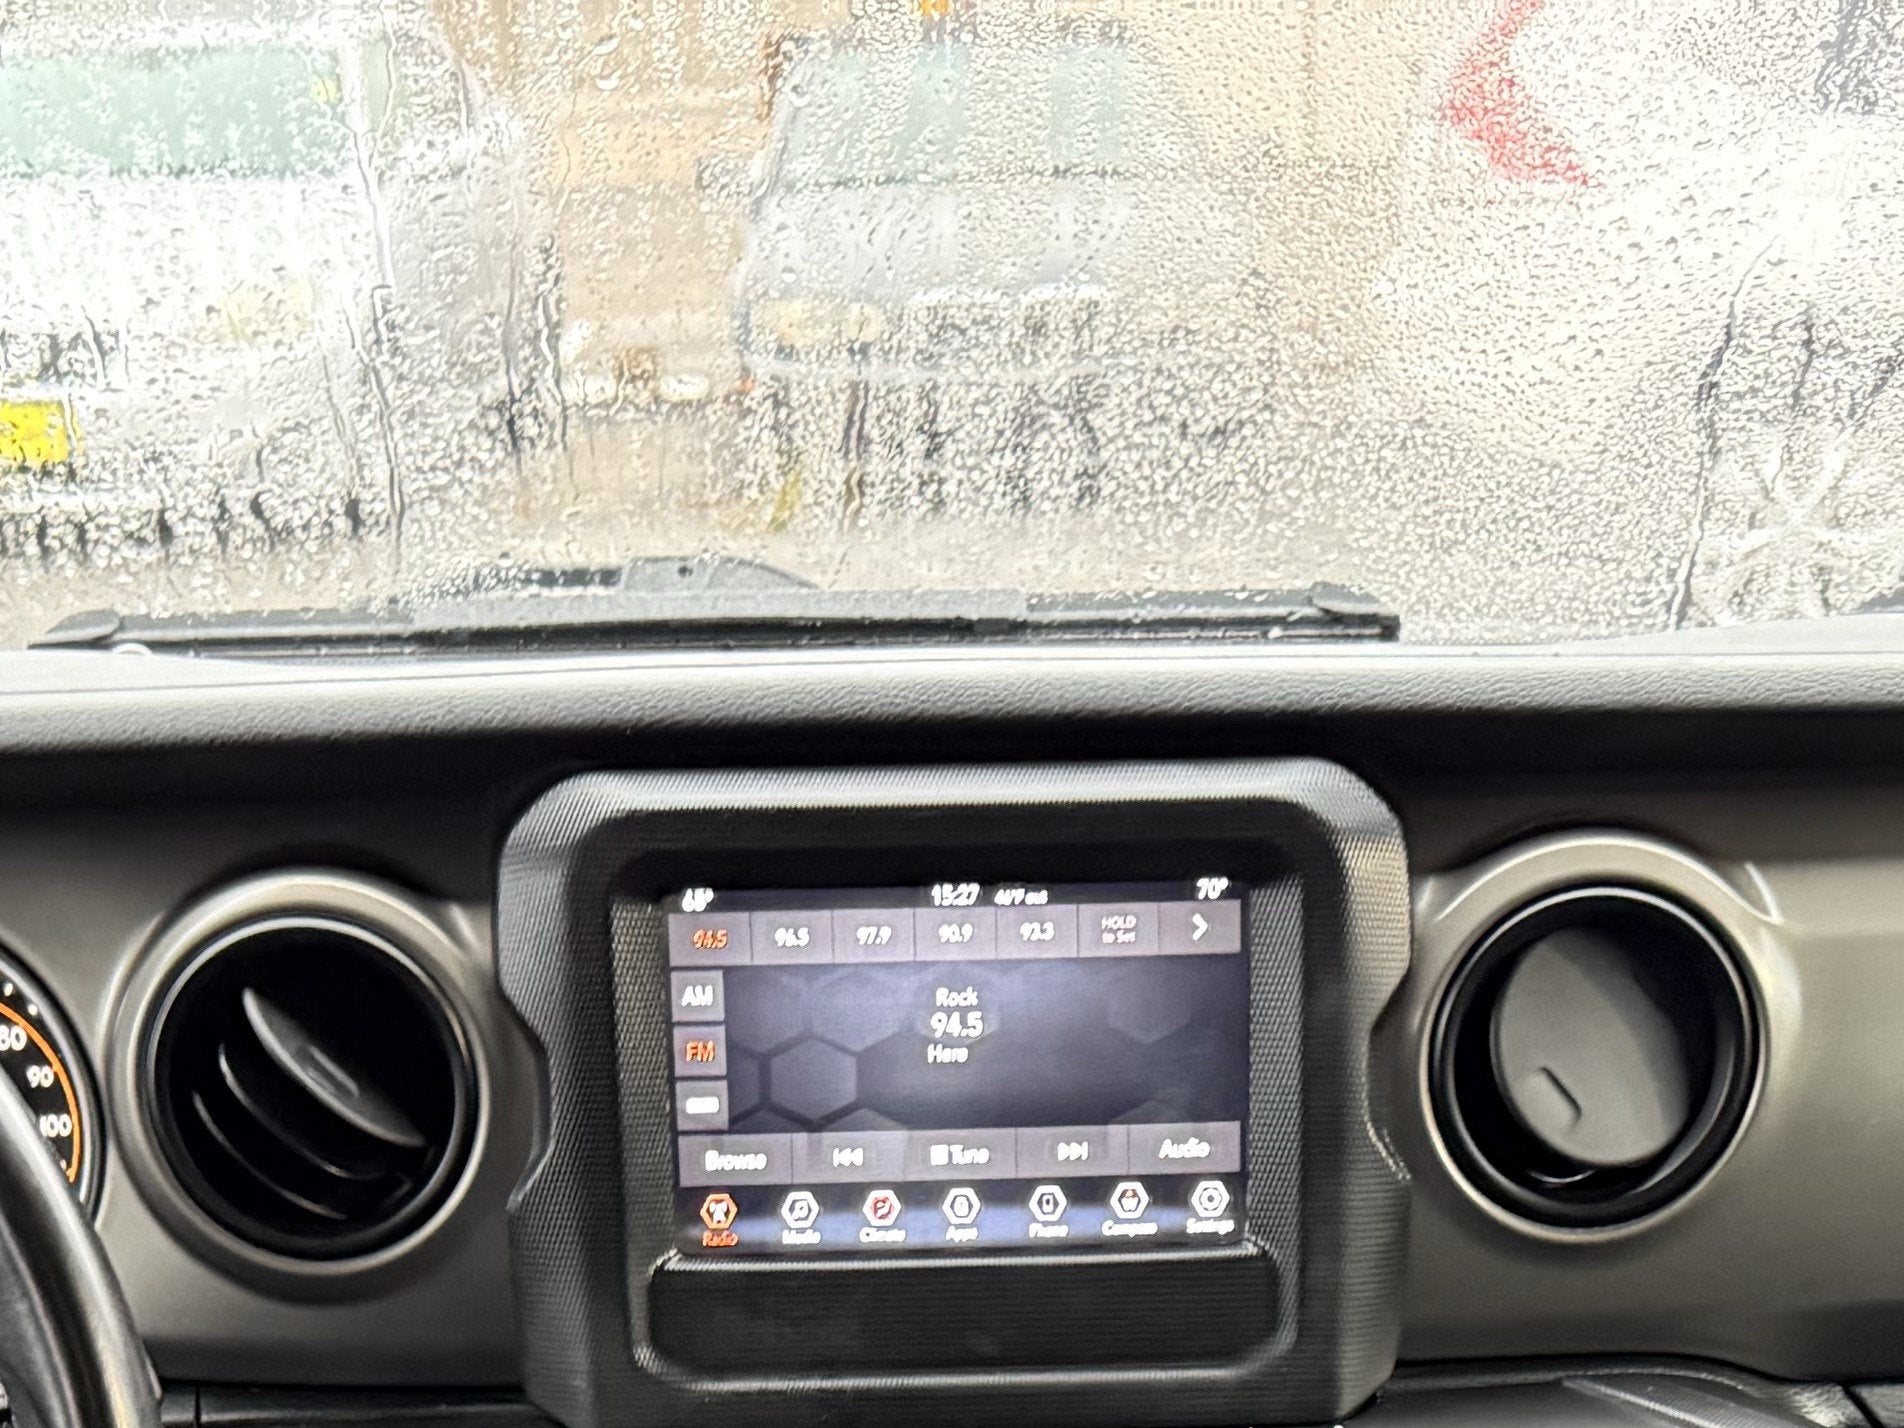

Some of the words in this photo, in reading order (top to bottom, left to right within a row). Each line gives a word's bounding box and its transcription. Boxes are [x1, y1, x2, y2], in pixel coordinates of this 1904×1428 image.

[682, 985, 713, 1006] AM
[930, 1013, 983, 1038] 94.5
[685, 1042, 715, 1061] FM
[27, 1065, 55, 1087] 90
[40, 1113, 72, 1137] 100
